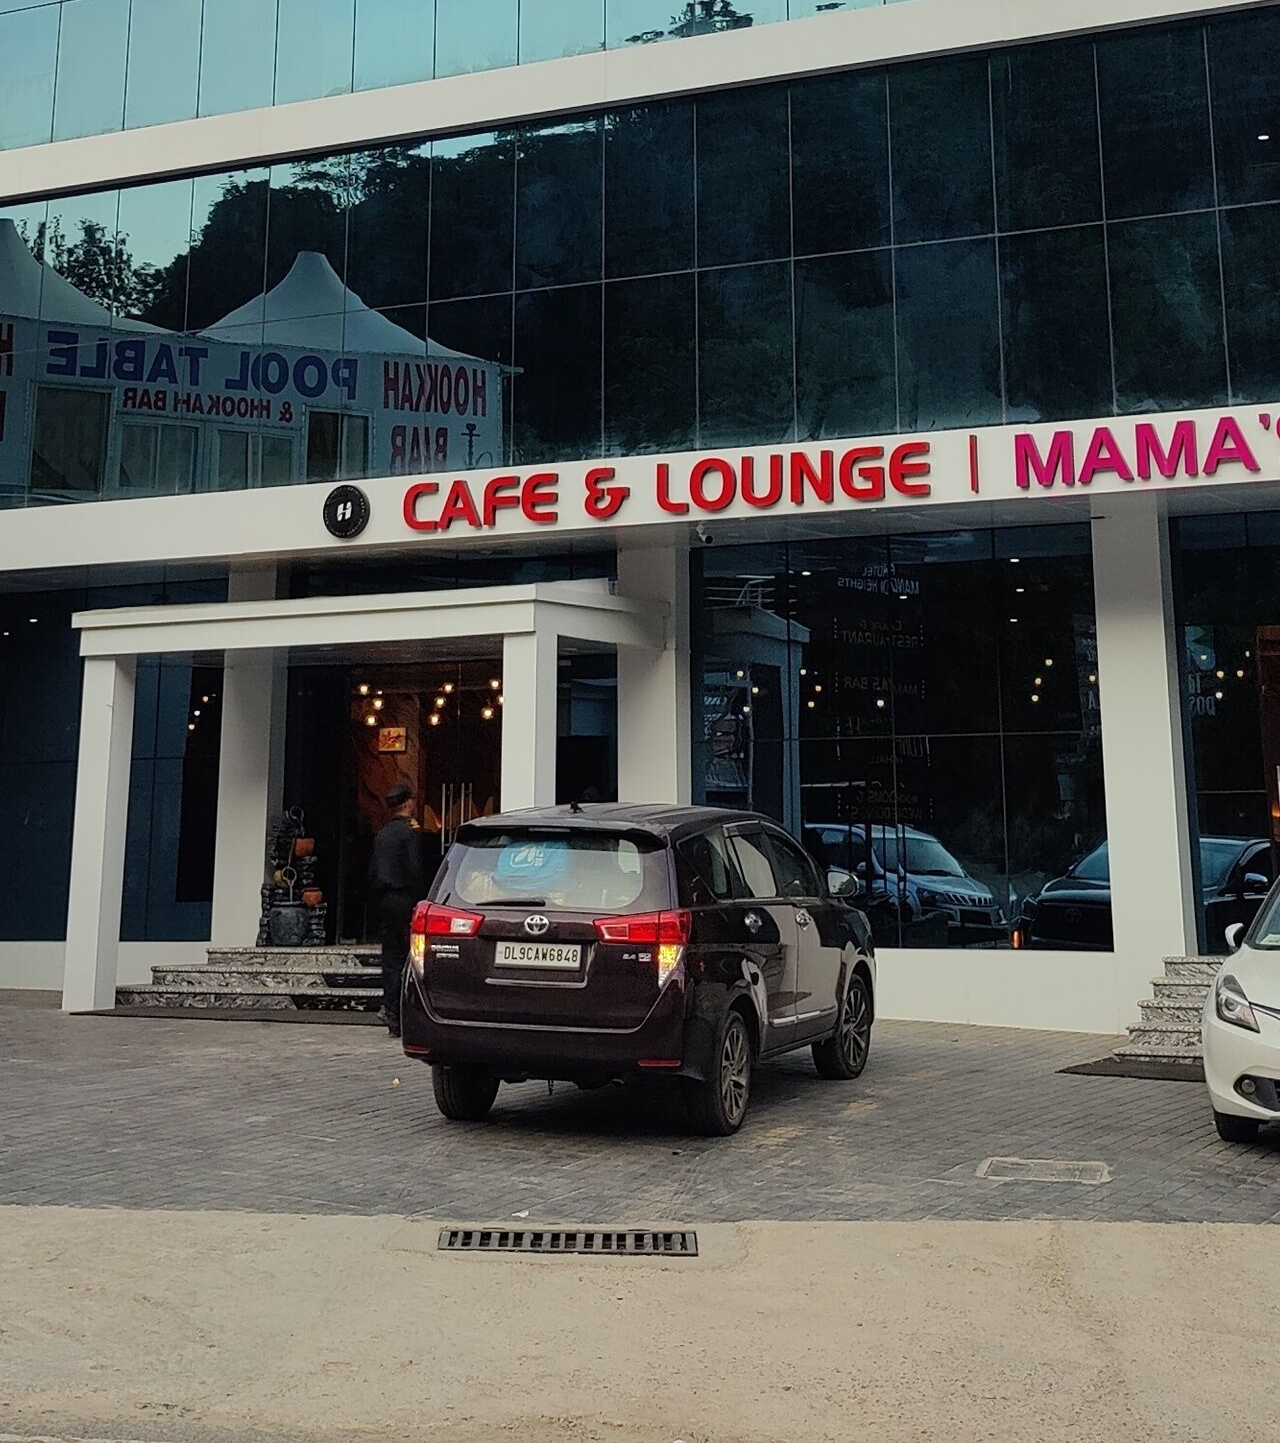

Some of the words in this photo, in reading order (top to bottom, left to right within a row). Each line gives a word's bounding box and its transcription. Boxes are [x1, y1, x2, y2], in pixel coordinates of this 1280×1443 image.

[403, 472, 560, 531] CAFE
[584, 467, 630, 520] &
[656, 441, 932, 514] LOUNGE
[503, 946, 579, 963] DL9CAW6848
